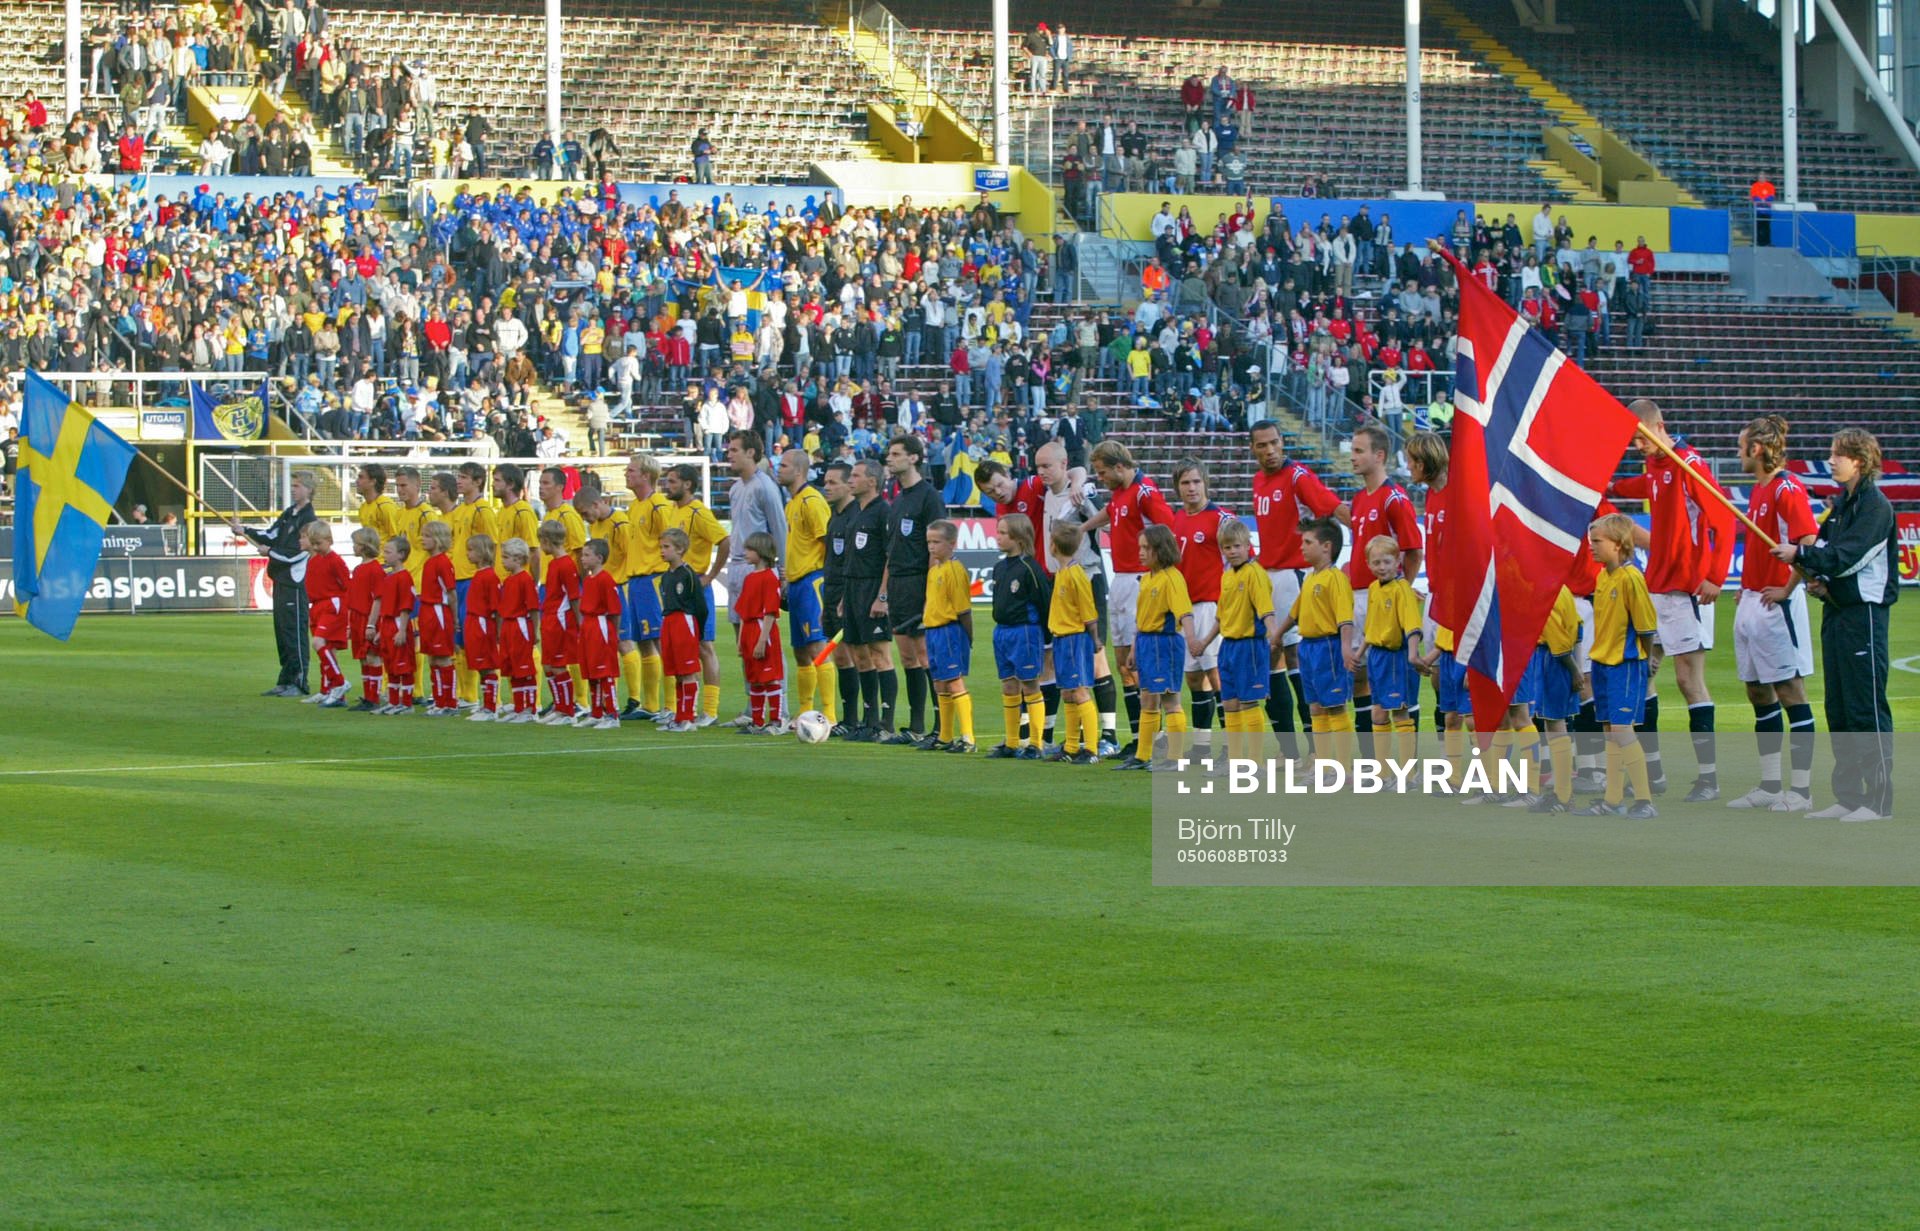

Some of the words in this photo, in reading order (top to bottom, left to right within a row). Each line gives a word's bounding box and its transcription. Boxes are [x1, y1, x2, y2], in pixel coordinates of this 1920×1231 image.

[1412, 91, 1419, 103] 3
[1787, 106, 1796, 119] 2
[146, 415, 182, 423] UTGÅNG
[1257, 495, 1270, 516] 10
[1180, 536, 1187, 558] 7
[641, 619, 650, 636] 3
